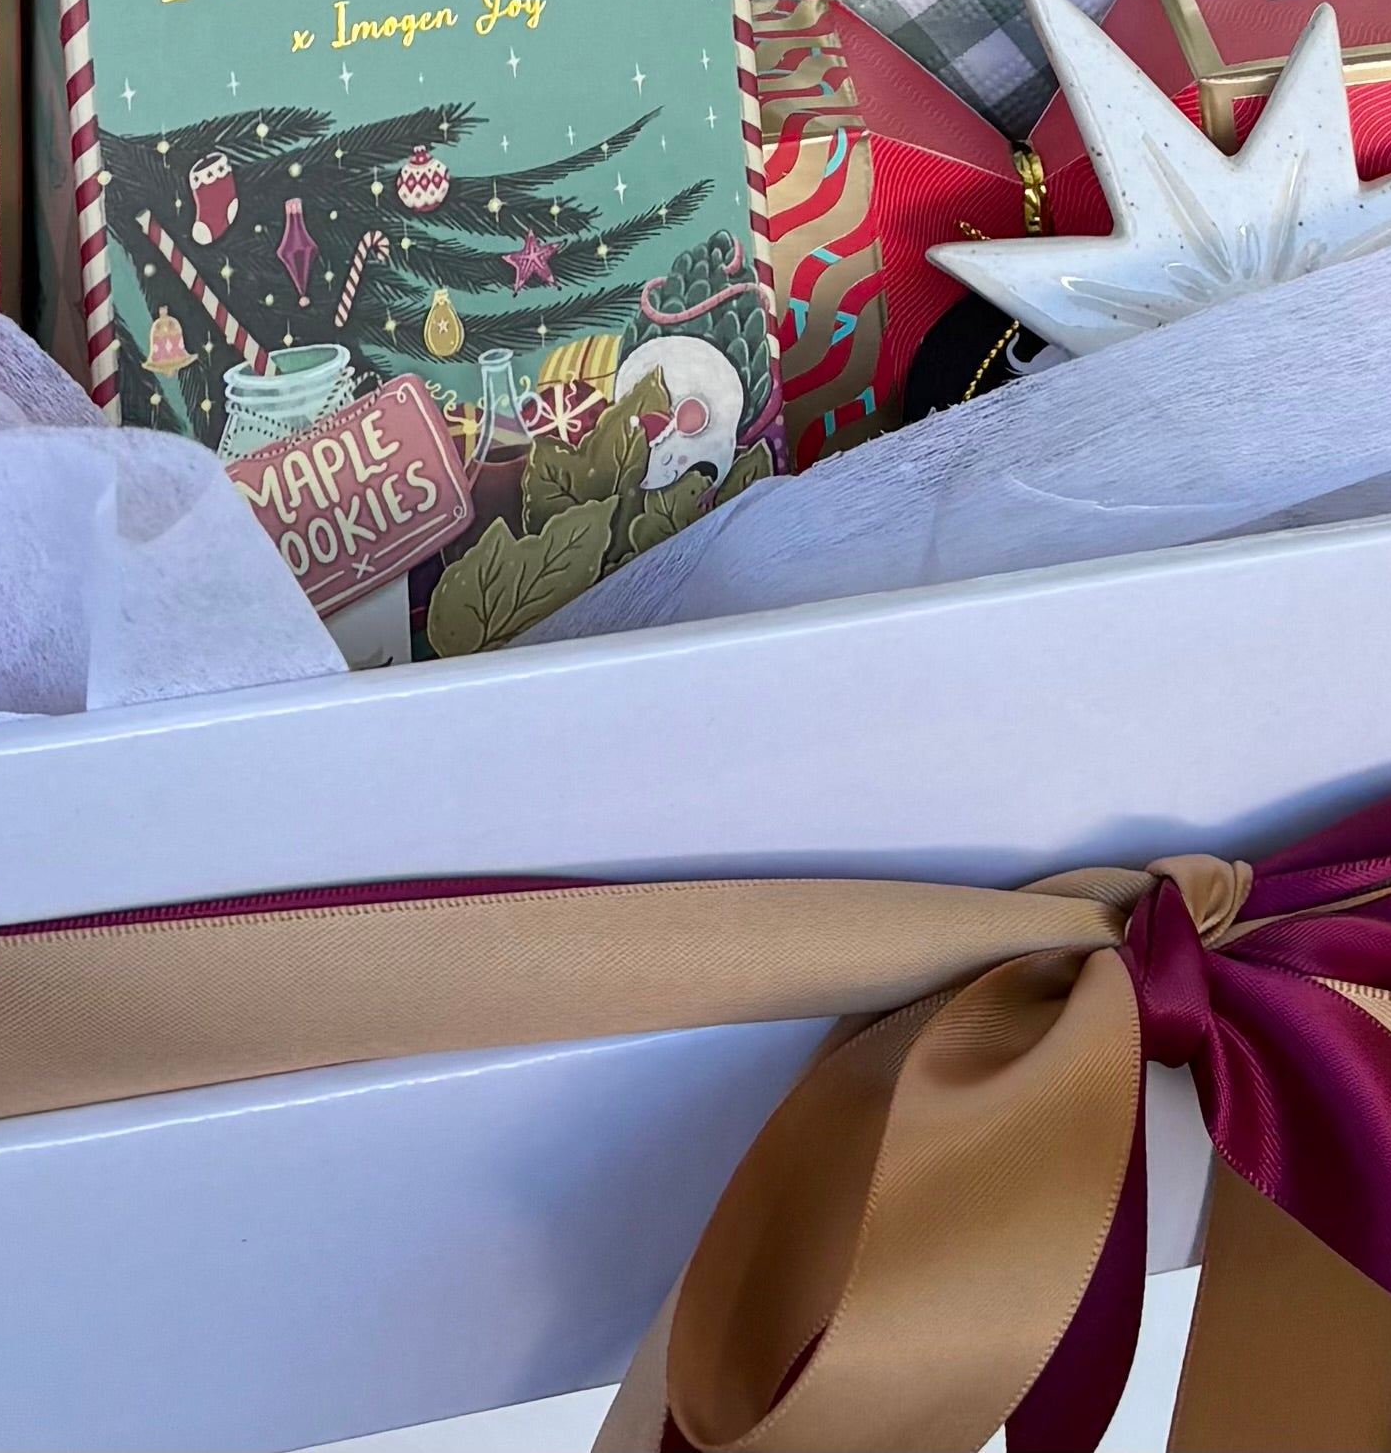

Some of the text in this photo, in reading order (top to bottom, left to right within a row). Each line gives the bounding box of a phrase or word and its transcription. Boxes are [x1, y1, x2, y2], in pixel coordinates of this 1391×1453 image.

[331, 0, 460, 49] Imogen
[236, 409, 400, 525] MAPLE
[278, 460, 438, 577] OOKIES
